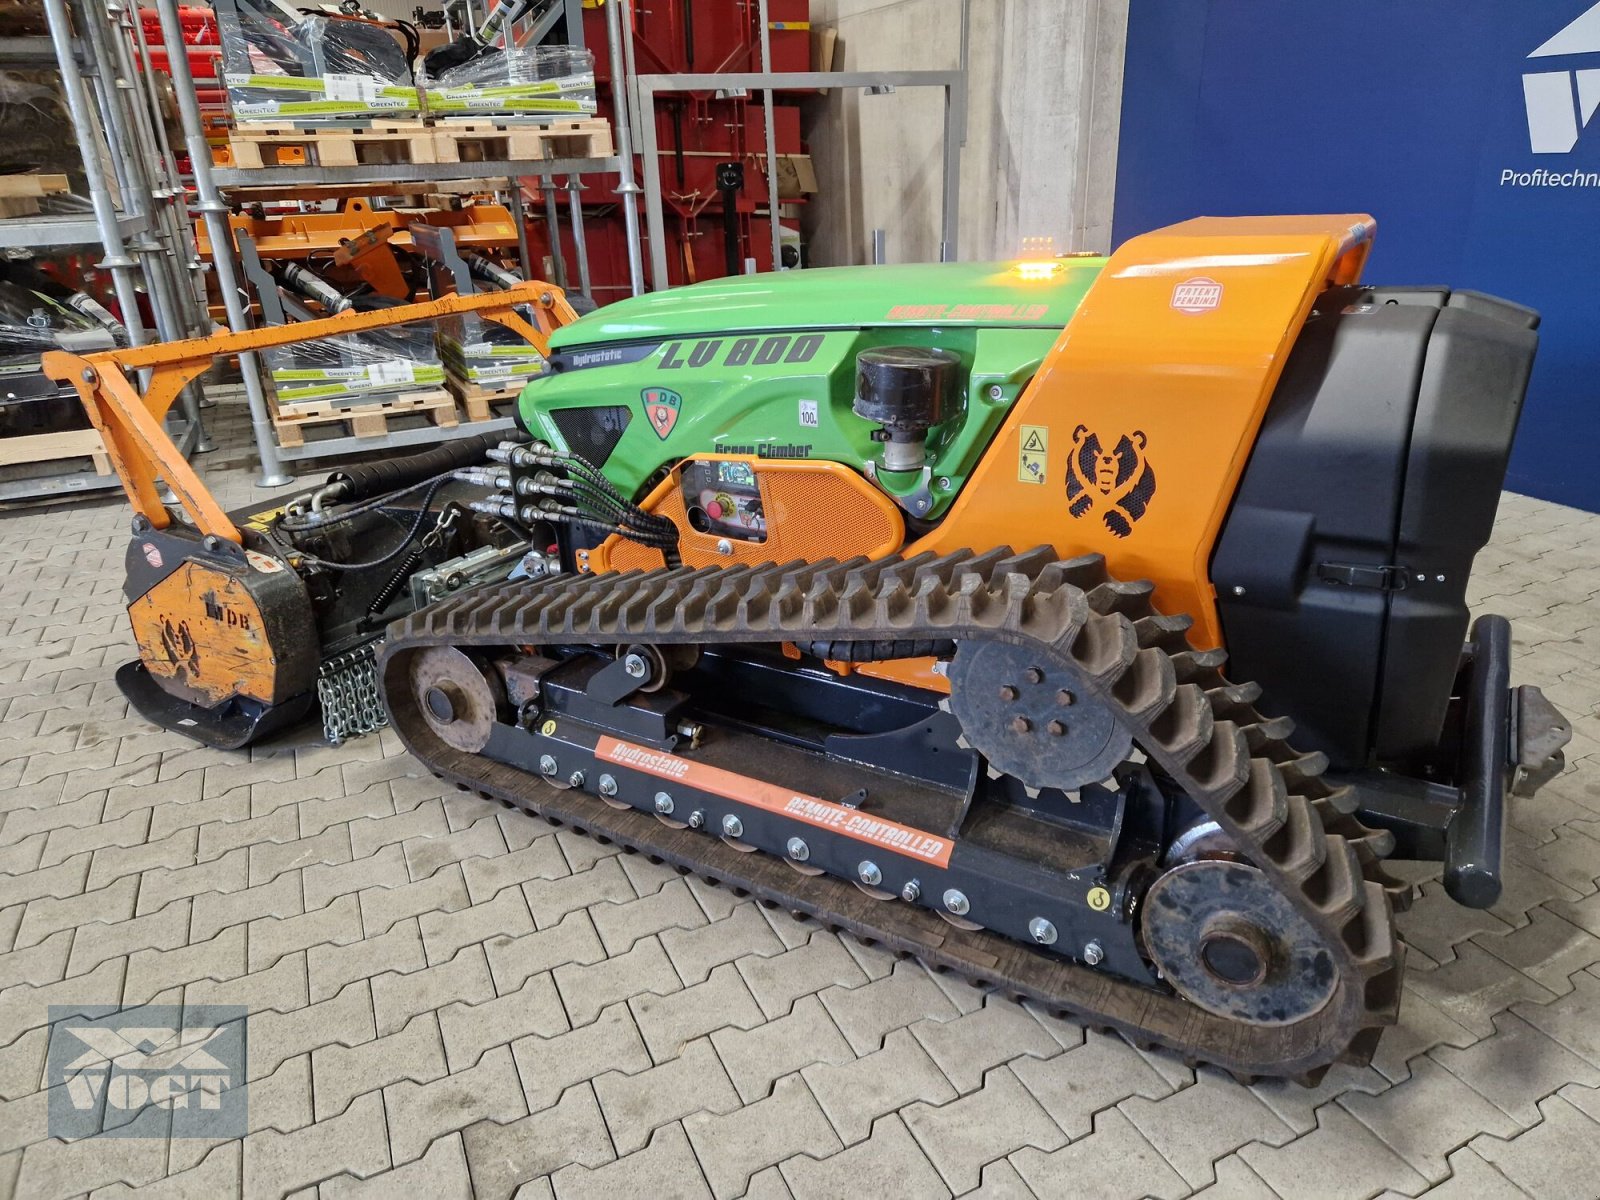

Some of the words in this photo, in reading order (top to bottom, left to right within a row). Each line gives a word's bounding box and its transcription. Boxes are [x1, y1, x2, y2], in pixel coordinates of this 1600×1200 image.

[1178, 287, 1218, 296] PATENT
[1174, 296, 1217, 305] PENDING
[572, 350, 622, 366] Hydrostatic
[656, 340, 723, 369] LV
[722, 334, 825, 366] 800
[758, 443, 812, 459] Climber
[610, 743, 689, 778] Hydrostatic
[783, 796, 944, 858] REMOTE-CONTROLLED
